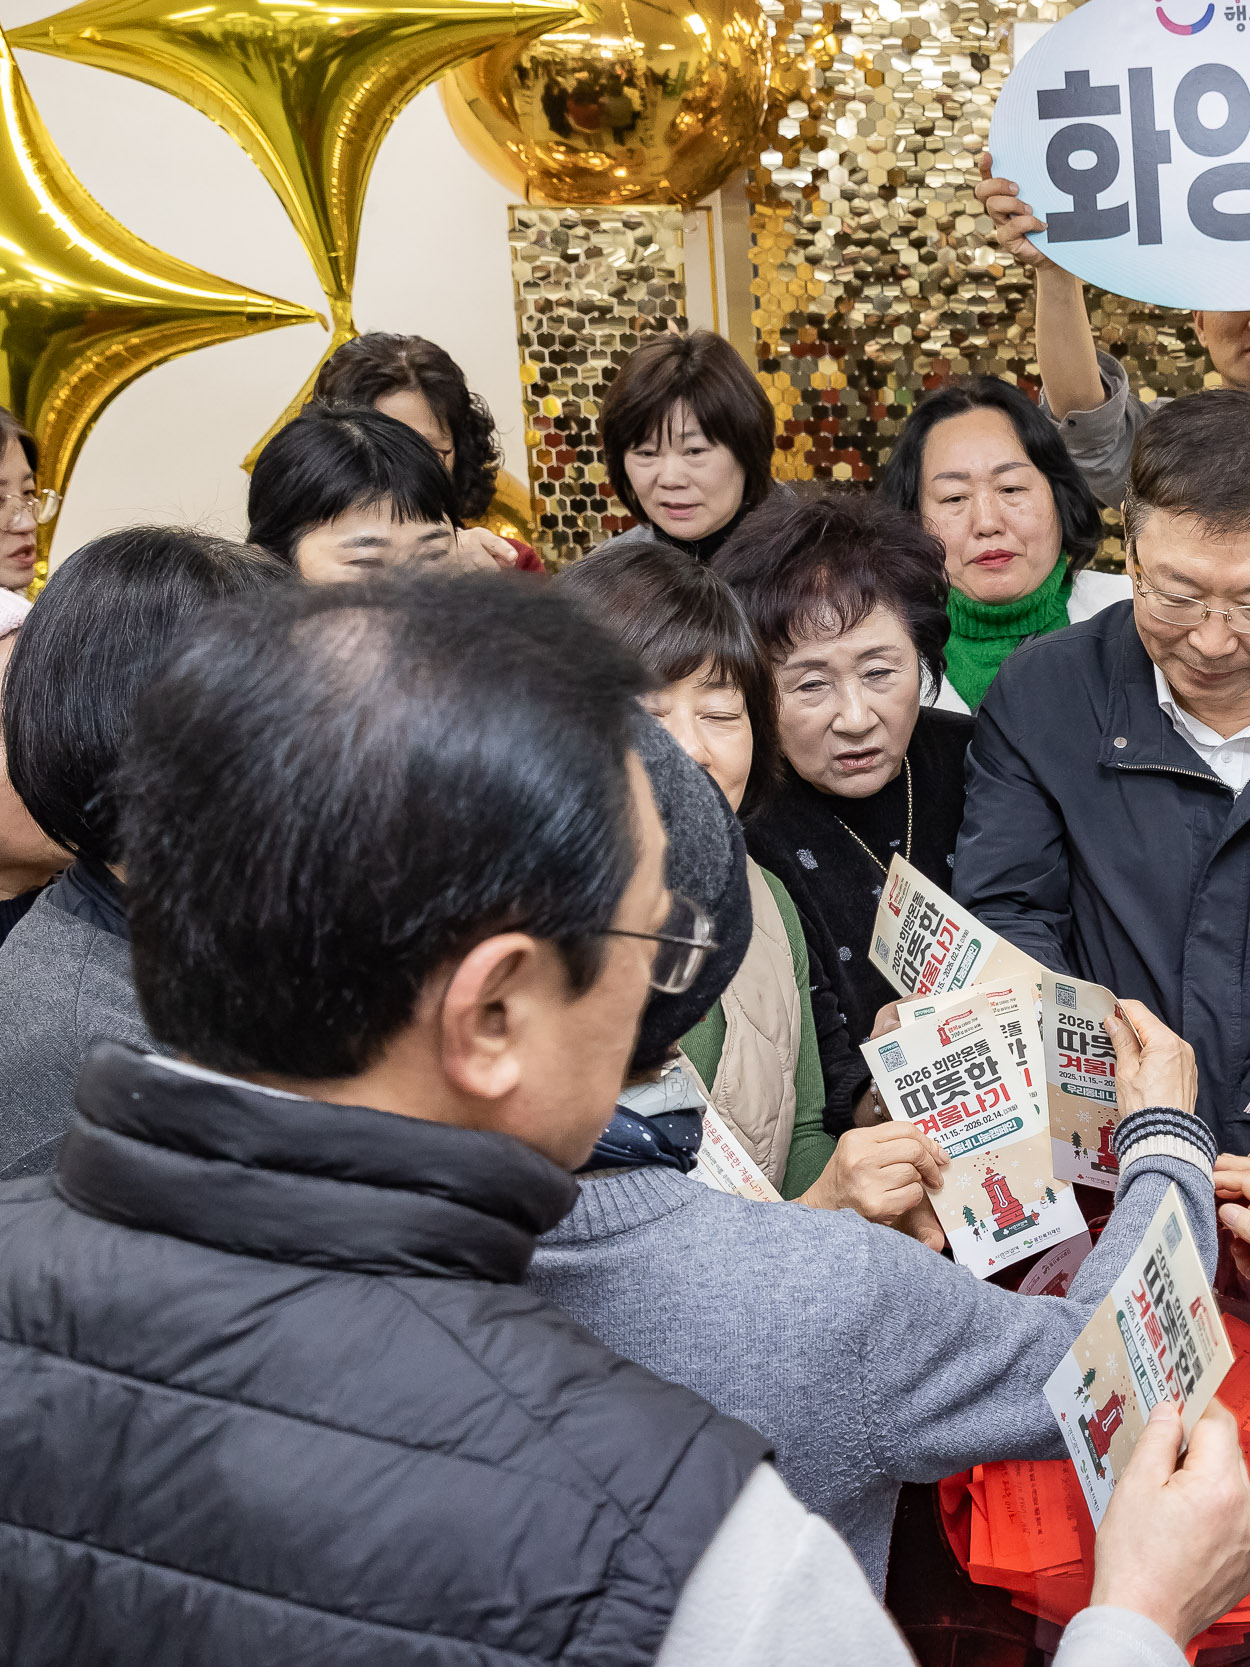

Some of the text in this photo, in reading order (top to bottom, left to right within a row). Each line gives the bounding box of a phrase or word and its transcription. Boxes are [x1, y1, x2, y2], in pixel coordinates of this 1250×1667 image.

[892, 942, 905, 975] 2026
[900, 890, 925, 944] 희망온돌
[900, 902, 945, 993] 따뜻한
[1057, 1027, 1117, 1060] 따뜻
[1058, 1013, 1094, 1031] 2026
[894, 1066, 932, 1091] 2026
[932, 1039, 992, 1075] 희망온돌
[899, 1055, 1002, 1119] 따뜻한
[1067, 1084, 1104, 1099] 우리동네
[913, 1082, 1012, 1135] 겨울나기
[703, 1117, 765, 1197] 망온돌 따뜻한 겨울나기
[945, 1139, 974, 1157] 리동네
[1155, 1243, 1175, 1295] 2026
[1132, 1279, 1184, 1416] 겨울나기
[1143, 1254, 1196, 1402] 따뜻한
